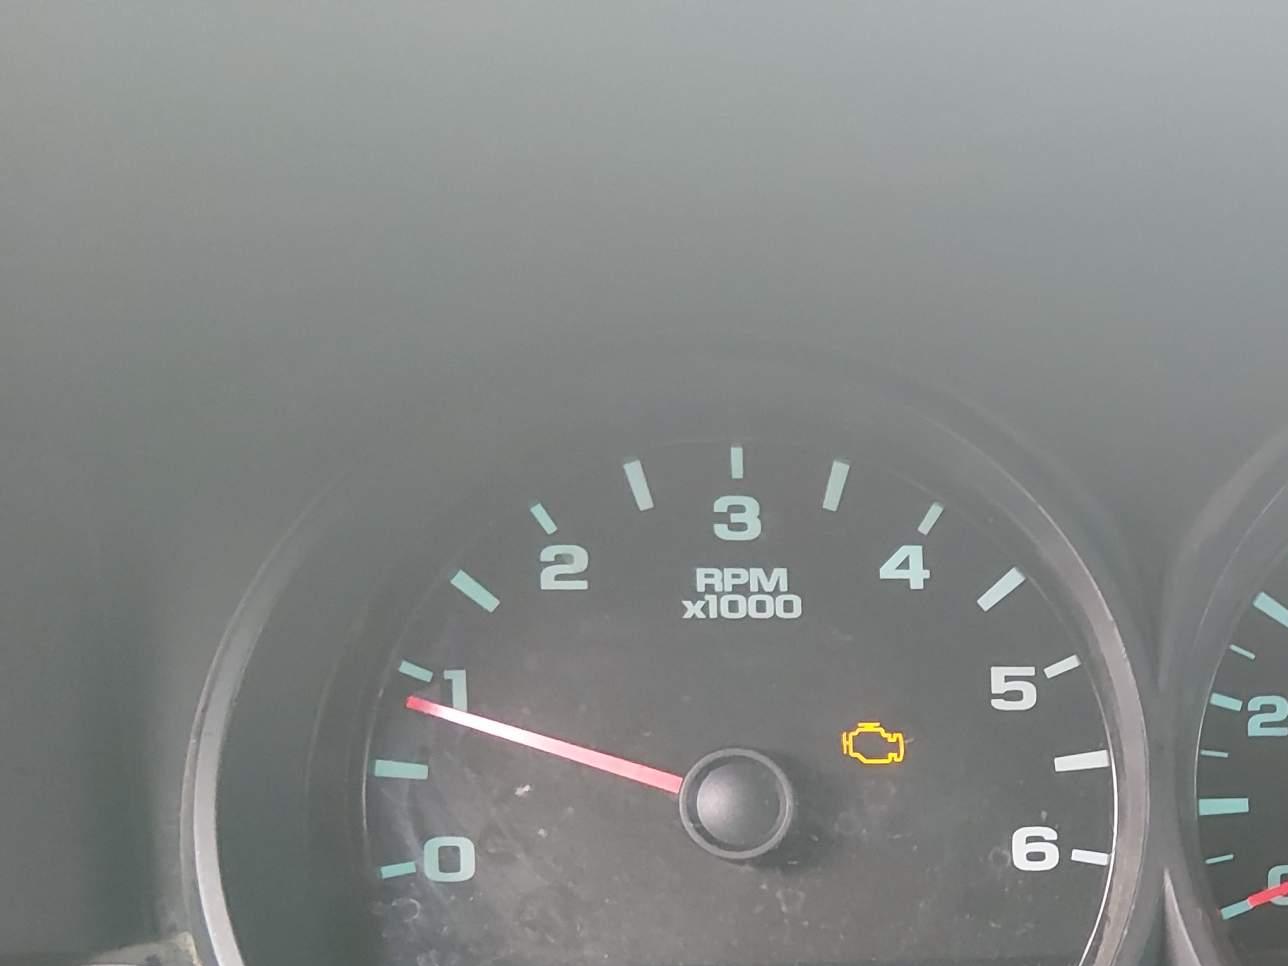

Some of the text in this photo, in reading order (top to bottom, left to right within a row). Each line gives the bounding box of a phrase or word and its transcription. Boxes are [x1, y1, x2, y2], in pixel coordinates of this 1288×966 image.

[712, 495, 763, 541] 3
[539, 545, 589, 590] 2
[695, 567, 789, 593] RPM
[879, 545, 930, 590] 4
[682, 594, 803, 620] x1000
[443, 669, 468, 711] 1
[990, 666, 1038, 711] 5
[423, 837, 475, 883] 0
[1011, 826, 1060, 872] 6
